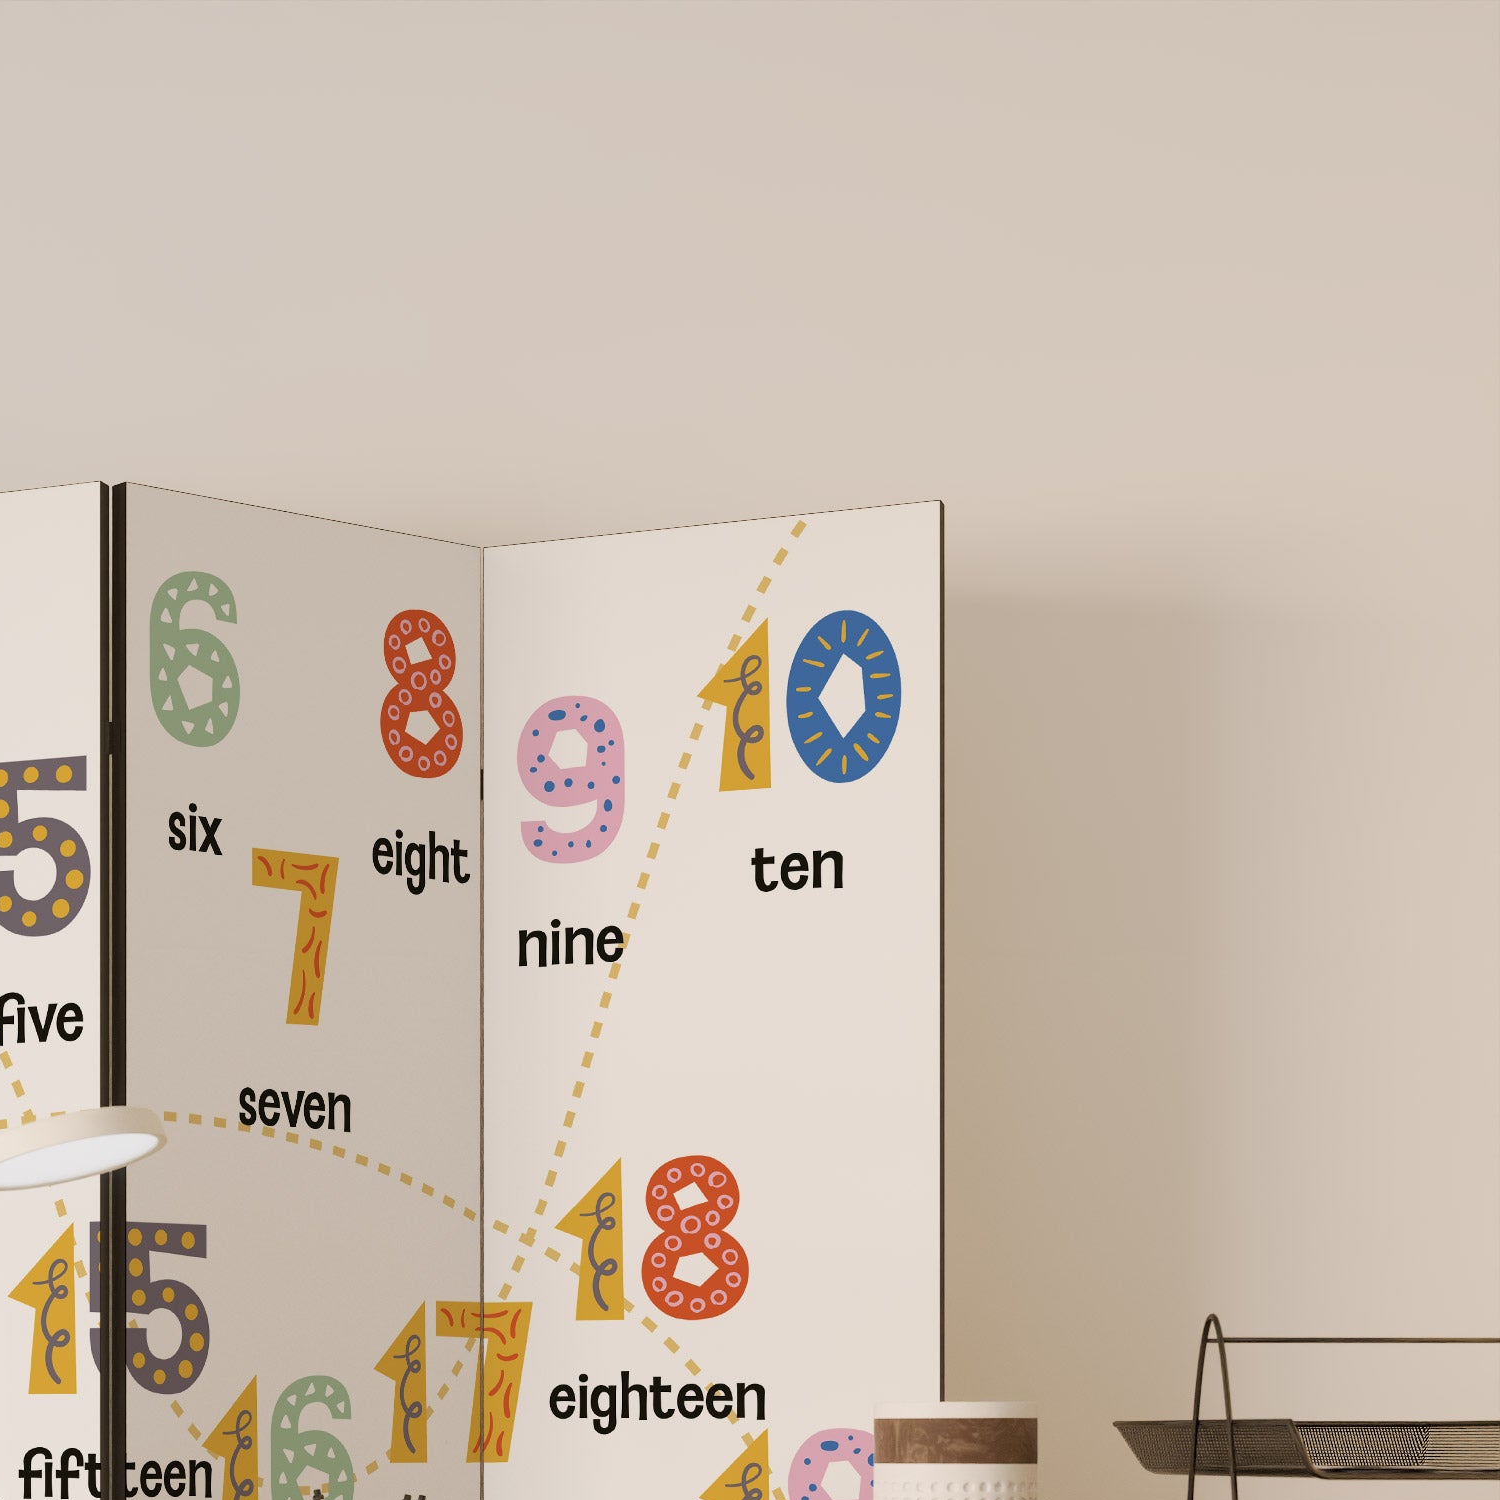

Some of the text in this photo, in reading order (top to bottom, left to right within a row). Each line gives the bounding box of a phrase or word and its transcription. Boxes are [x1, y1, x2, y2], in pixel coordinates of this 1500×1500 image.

[149, 571, 240, 747] 6
[380, 609, 464, 778] 8
[696, 610, 901, 792] 10
[169, 803, 222, 856] six
[517, 695, 625, 863] 9
[252, 847, 339, 1026] 7
[373, 830, 470, 895] eight
[518, 919, 624, 967] nine
[752, 847, 844, 892] ten
[239, 1087, 351, 1132] seven
[8, 1222, 209, 1394] 15
[555, 1155, 749, 1321] 18
[373, 1300, 533, 1463] 17
[550, 1371, 766, 1434] eighteen
